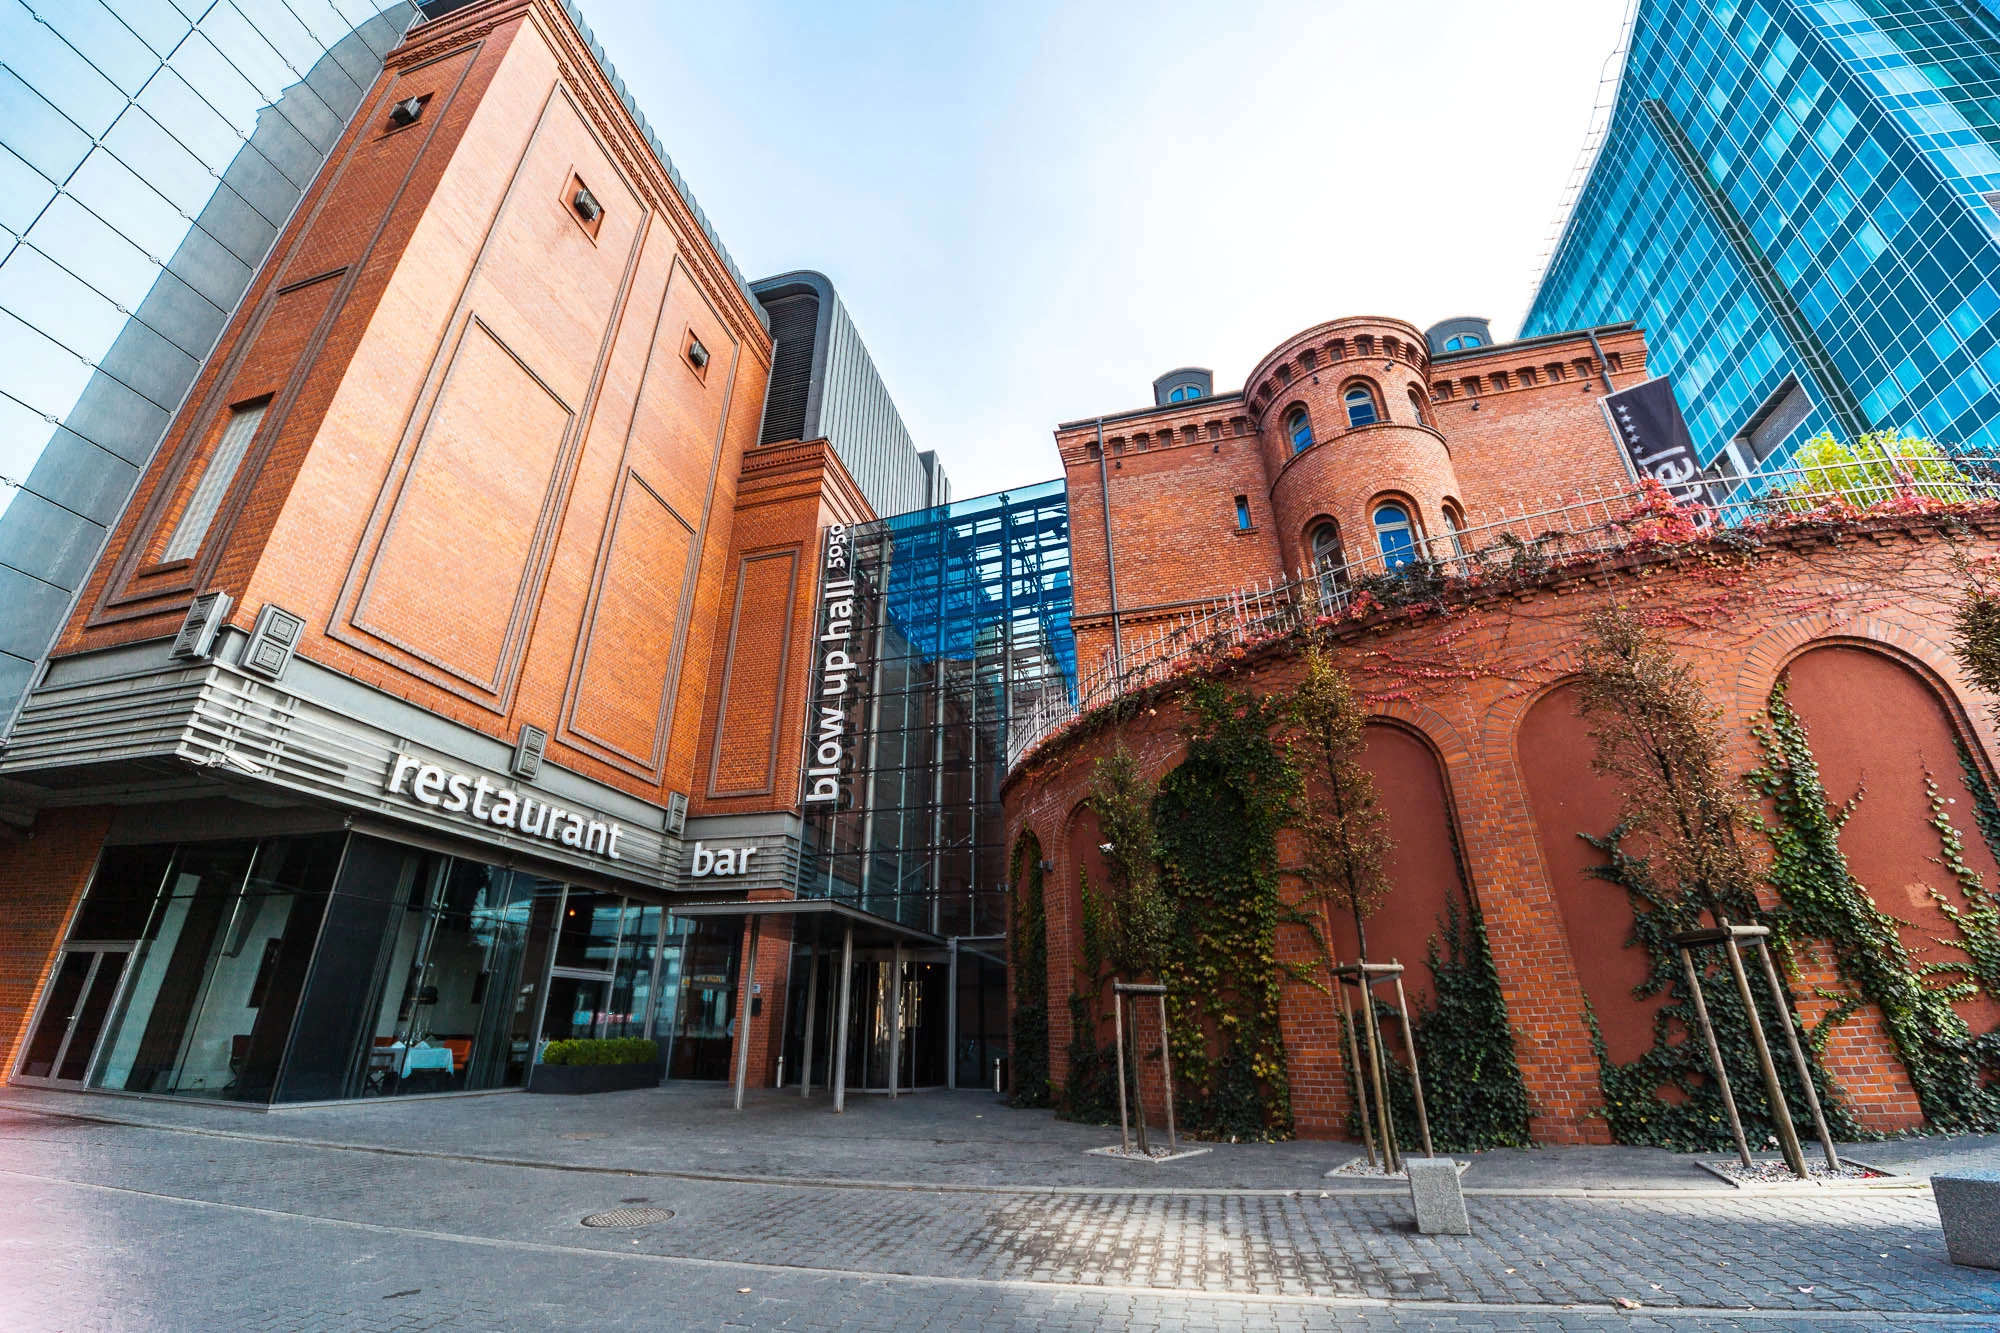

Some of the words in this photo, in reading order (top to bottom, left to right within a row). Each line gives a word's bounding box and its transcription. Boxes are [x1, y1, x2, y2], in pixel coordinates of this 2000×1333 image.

[829, 524, 847, 569] 5050
[821, 580, 855, 640] hall
[823, 651, 857, 696] up
[806, 708, 844, 802] blow
[389, 755, 622, 859] restaurant
[692, 843, 757, 877] bar
